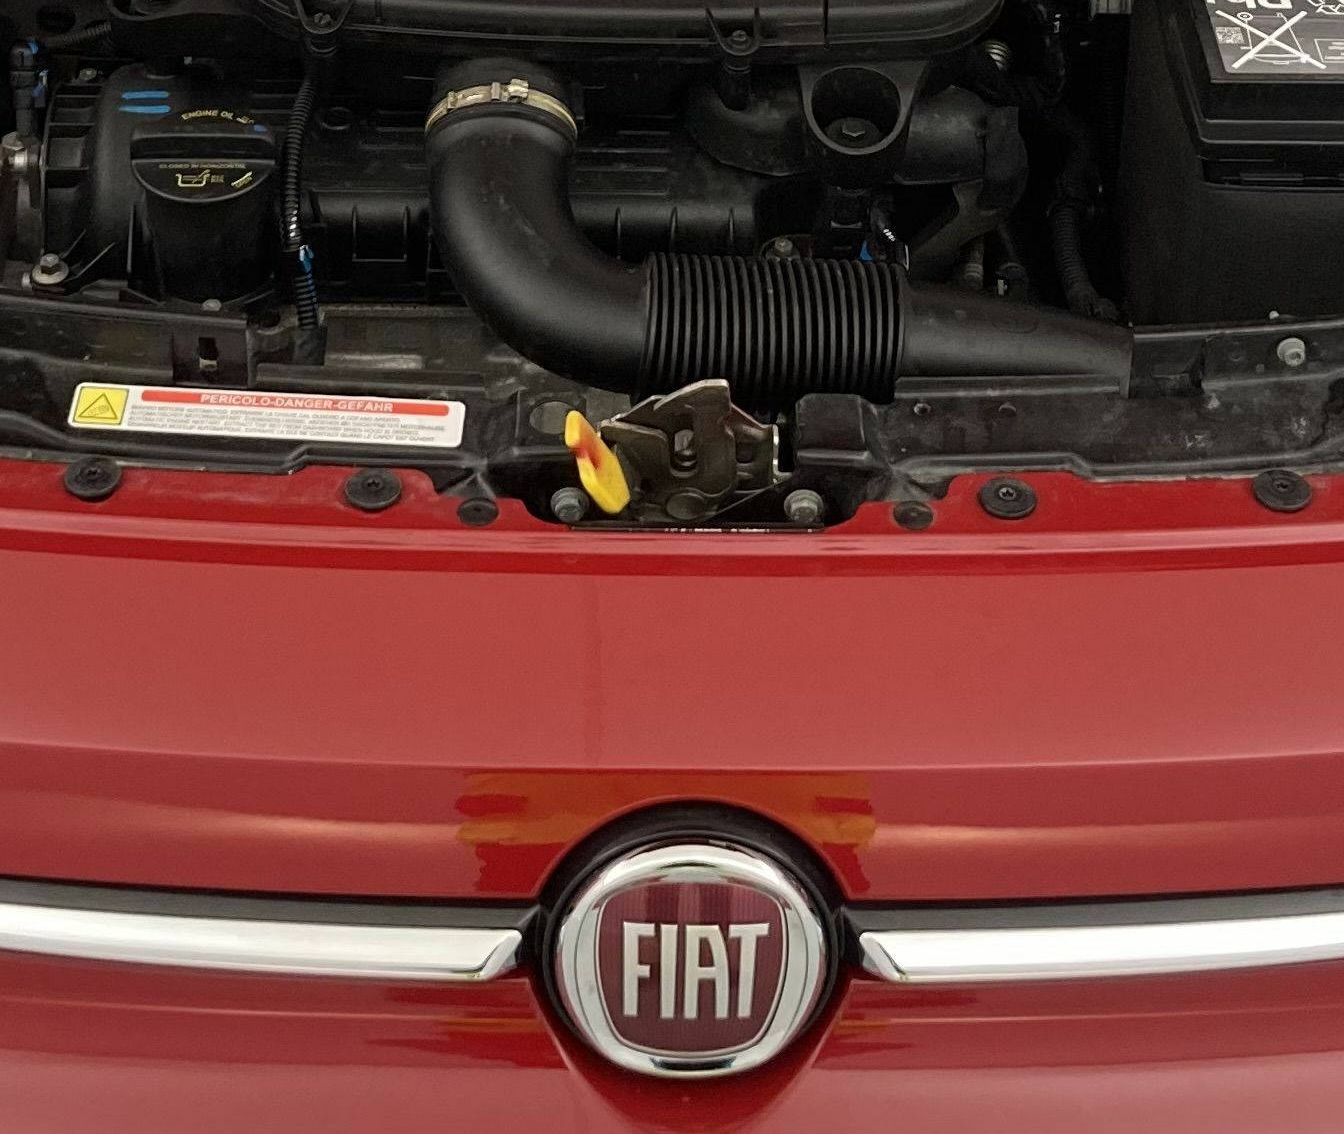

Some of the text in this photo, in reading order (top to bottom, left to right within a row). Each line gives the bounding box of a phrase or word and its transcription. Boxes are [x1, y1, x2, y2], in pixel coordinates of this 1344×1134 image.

[181, 110, 234, 120] ENGINE OIL
[200, 394, 393, 413] PERICOLO-DANGER-GEFAHR
[622, 921, 770, 1019] FIAT
